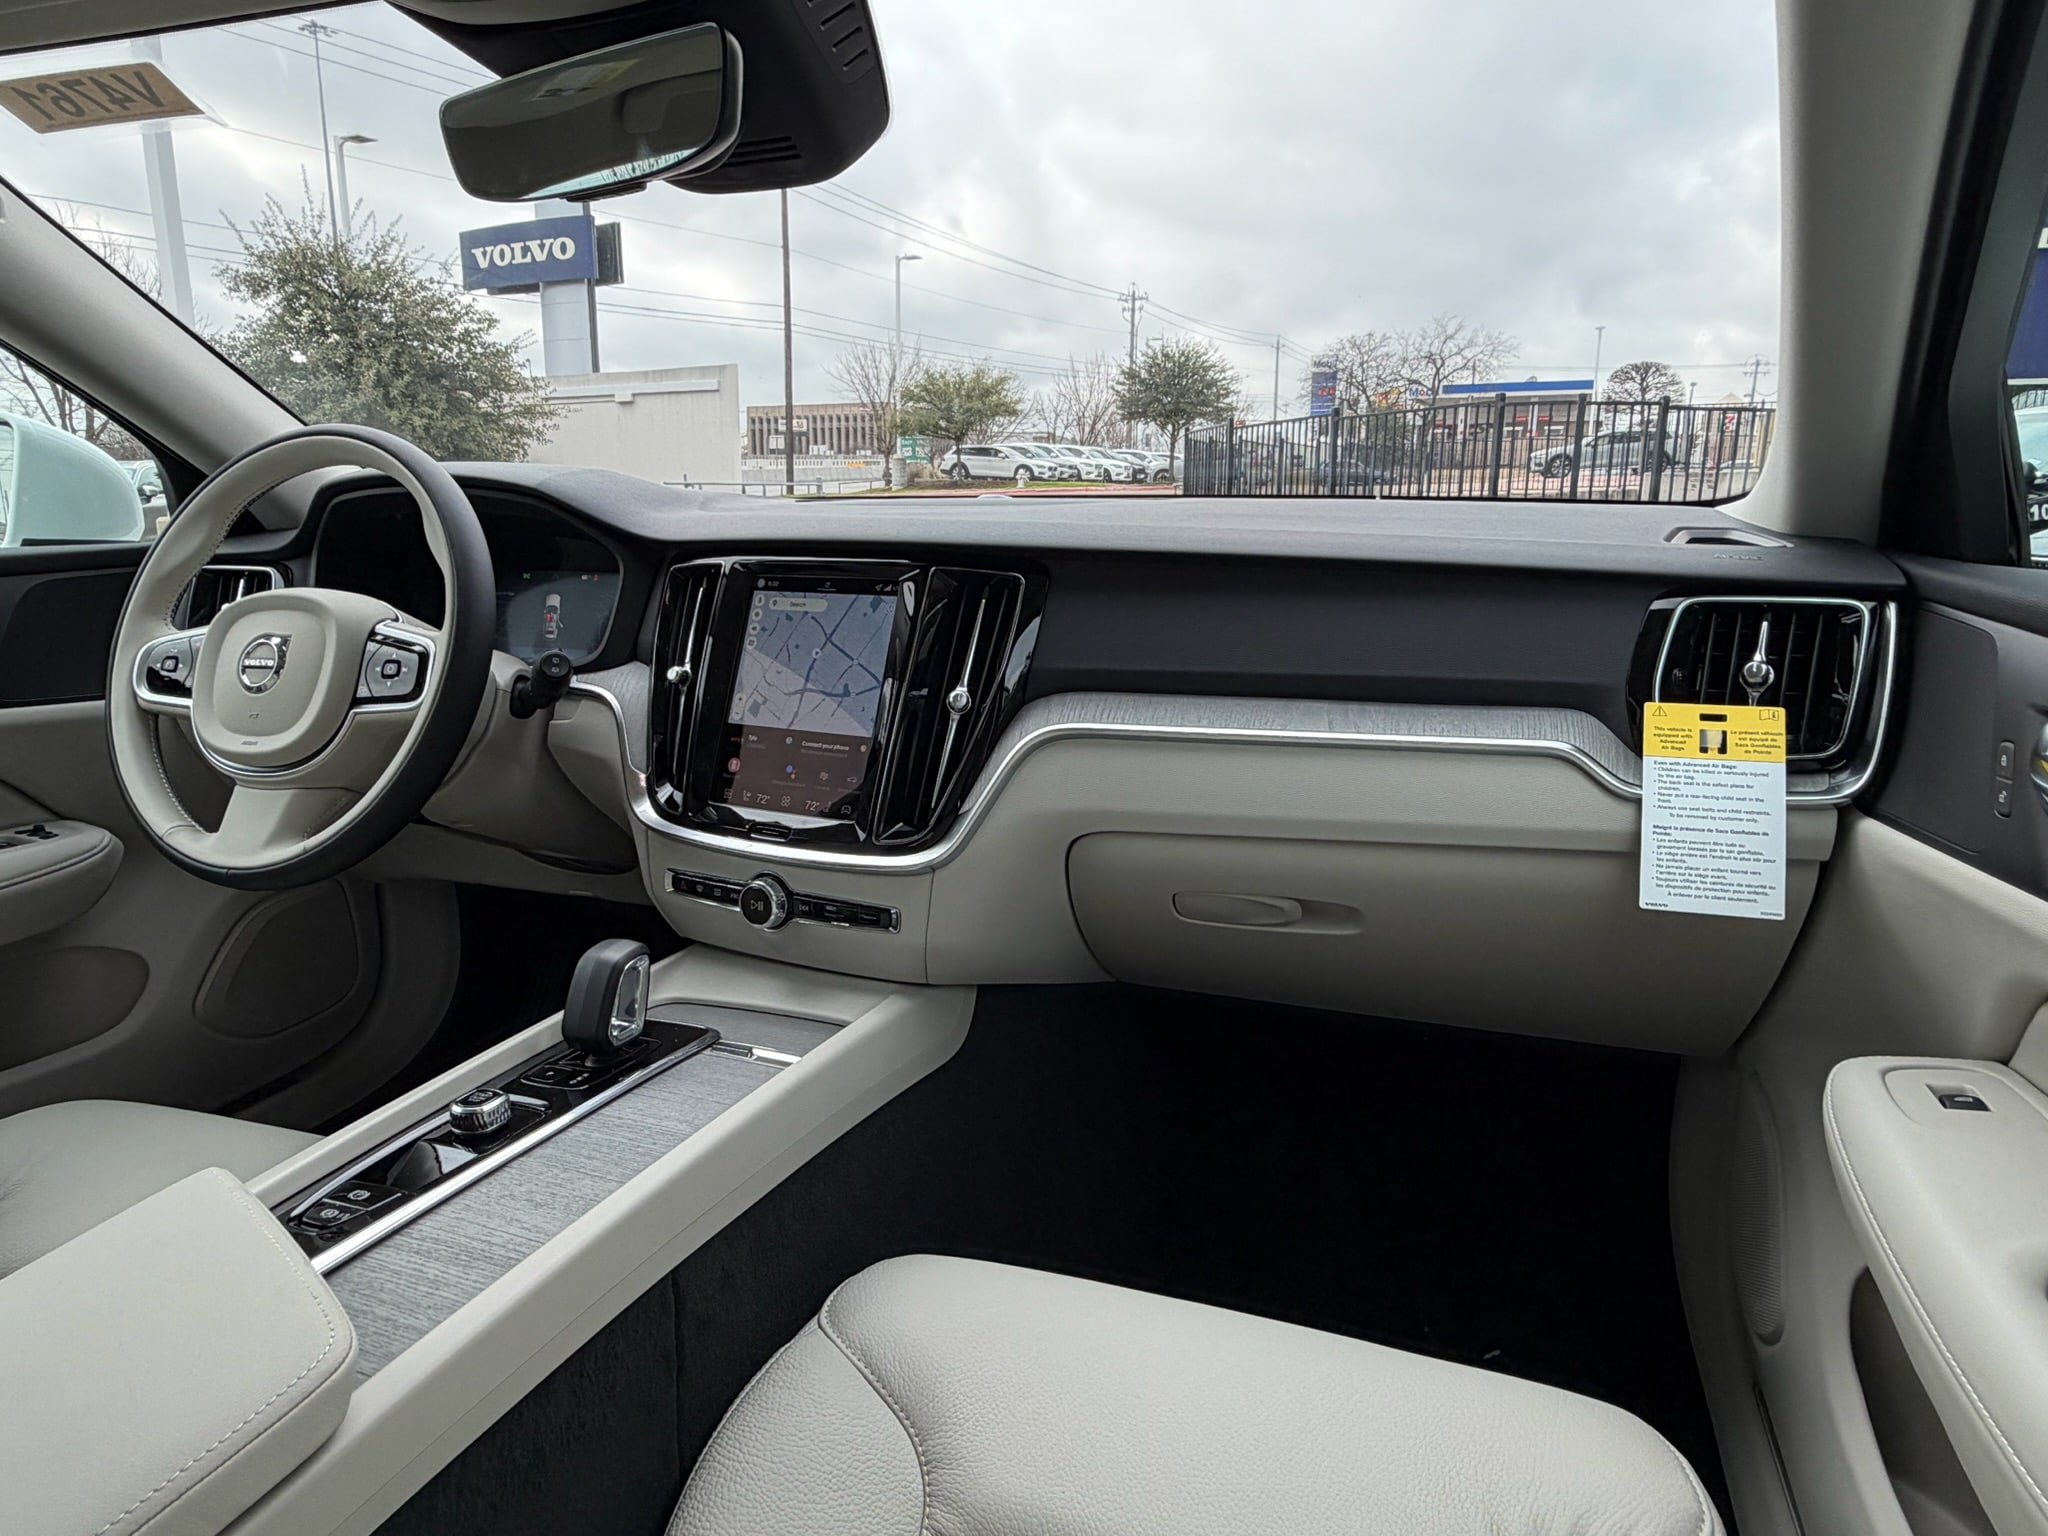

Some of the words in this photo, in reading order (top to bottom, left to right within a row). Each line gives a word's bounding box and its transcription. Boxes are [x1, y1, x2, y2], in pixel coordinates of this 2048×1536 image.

[472, 237, 576, 269] VOLVO
[244, 658, 274, 666] VOLVO
[801, 740, 821, 748] Connect
